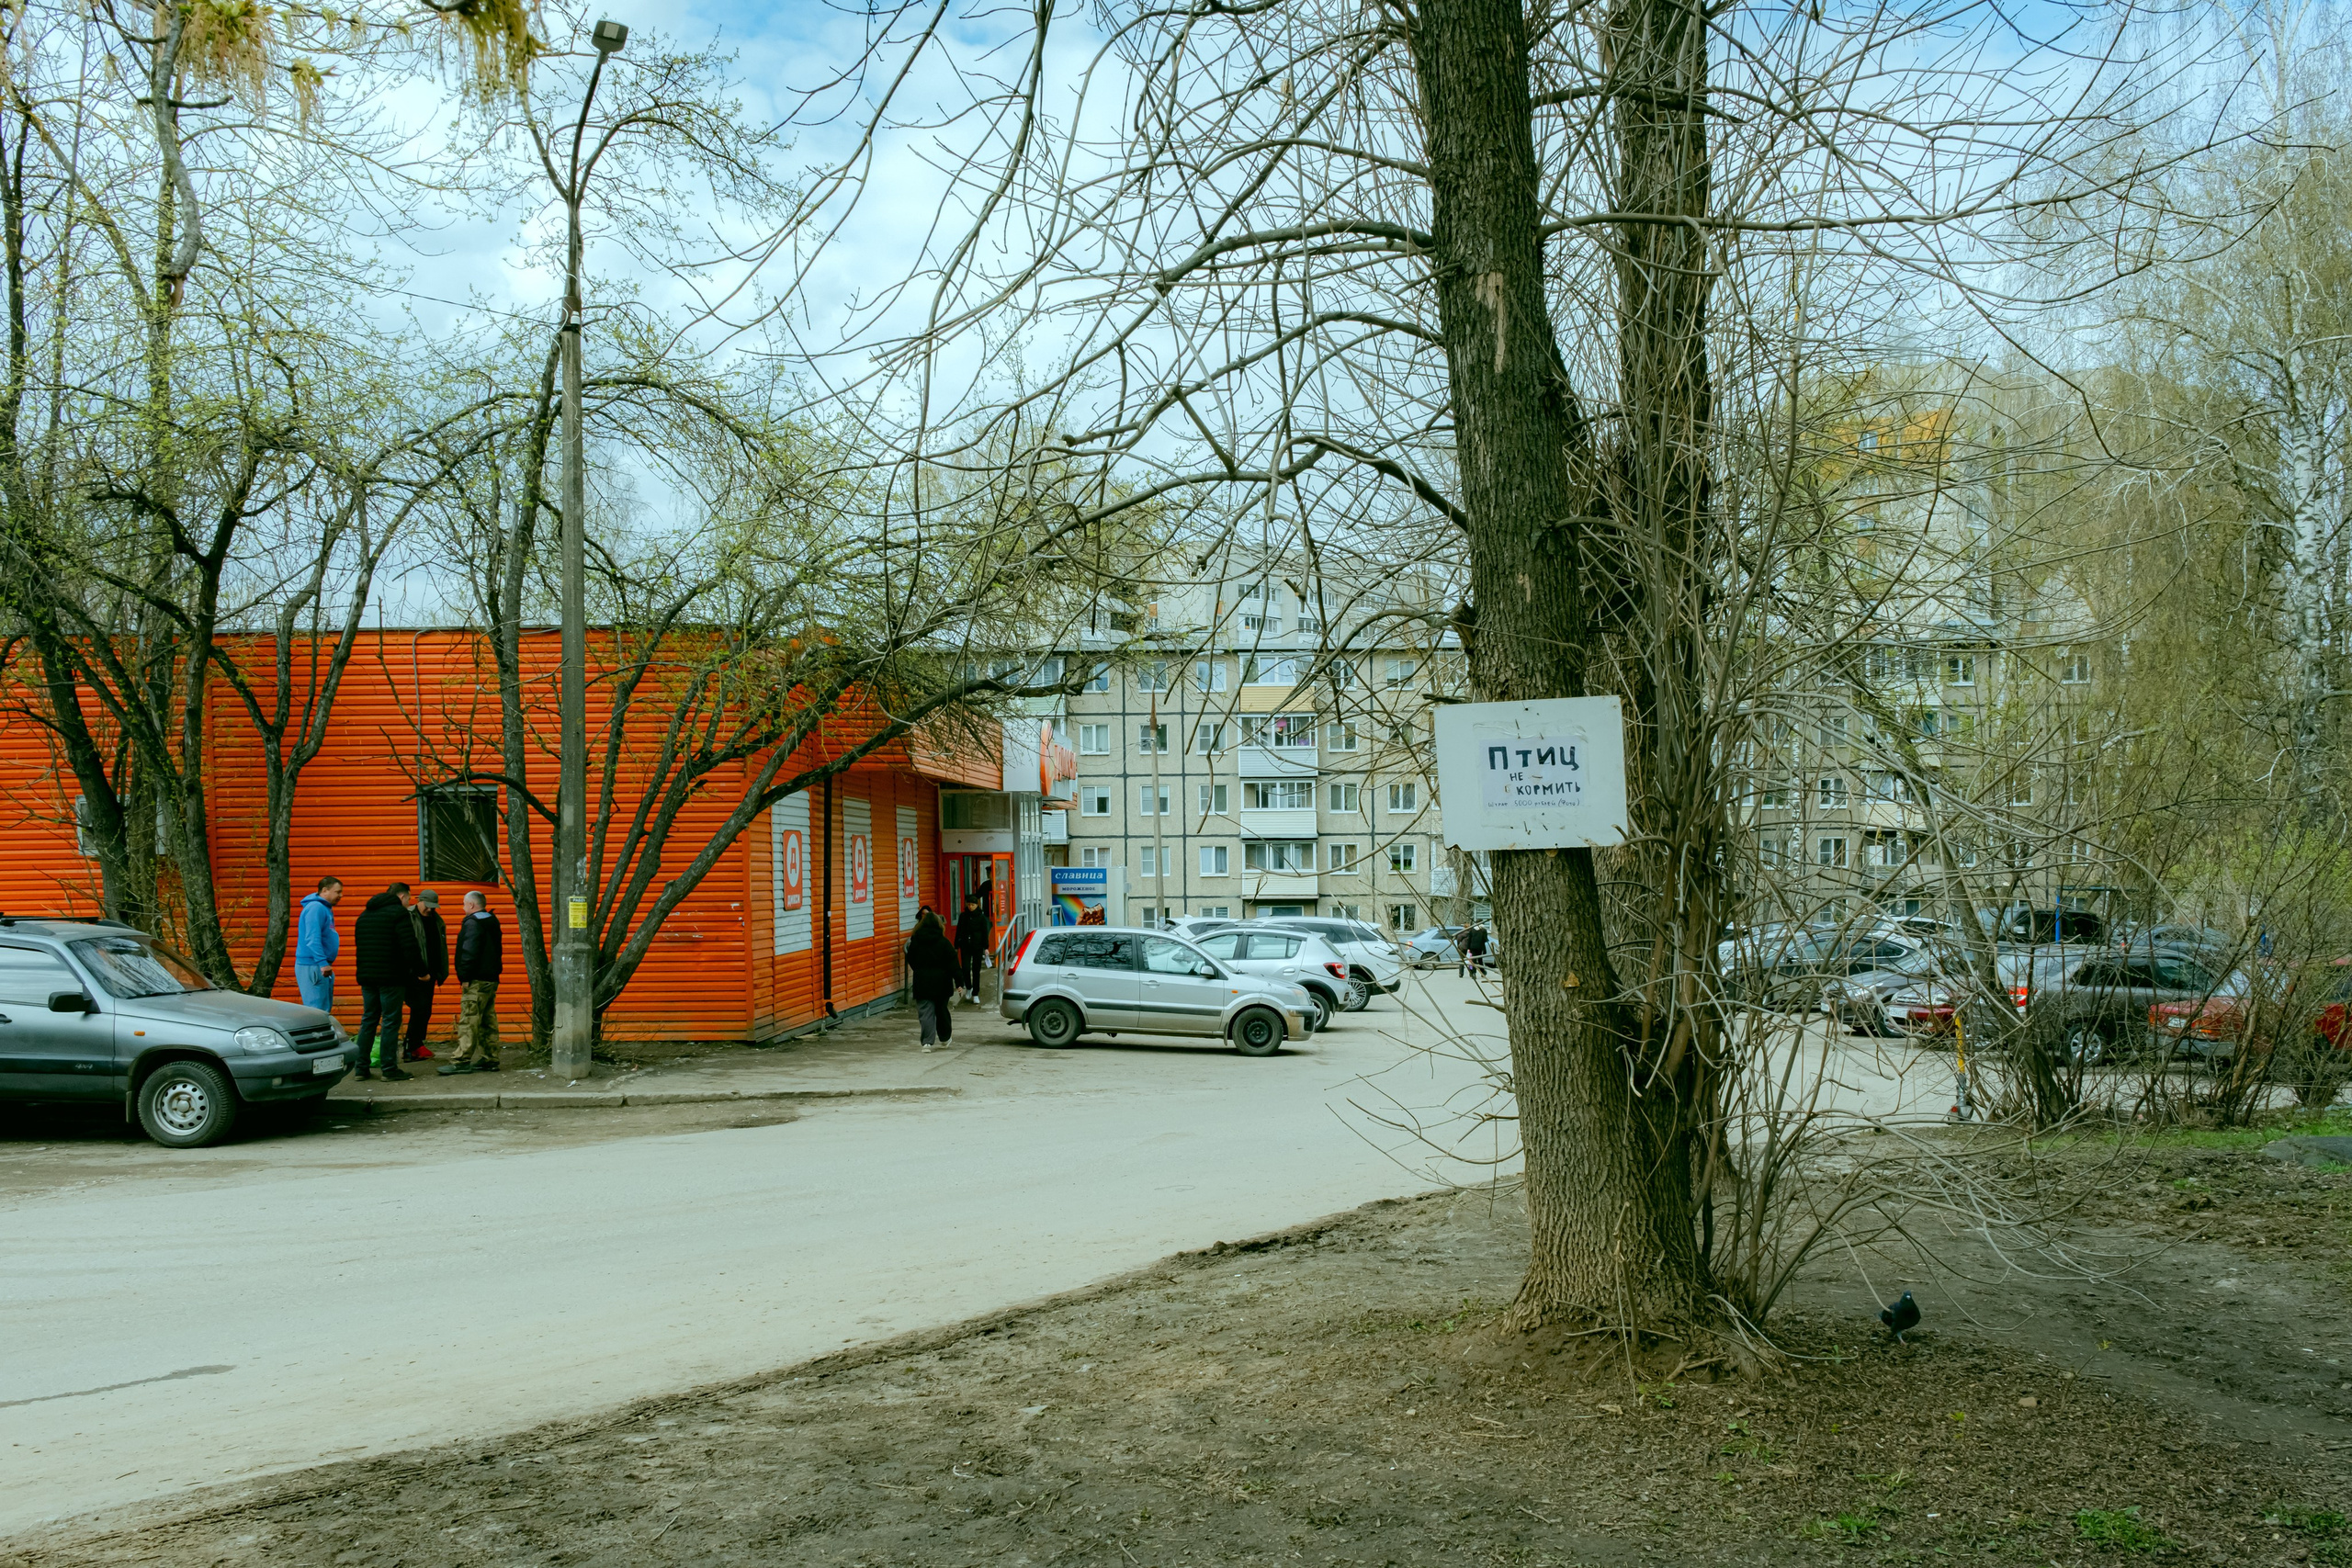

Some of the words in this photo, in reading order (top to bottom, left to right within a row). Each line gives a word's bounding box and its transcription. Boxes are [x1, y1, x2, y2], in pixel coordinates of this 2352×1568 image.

[1488, 746, 1579, 771] ПТИЦ
[1510, 773, 1523, 781] НЕ
[1516, 782, 1581, 795] КОРМИТЬ
[1514, 799, 1532, 807] 5000
